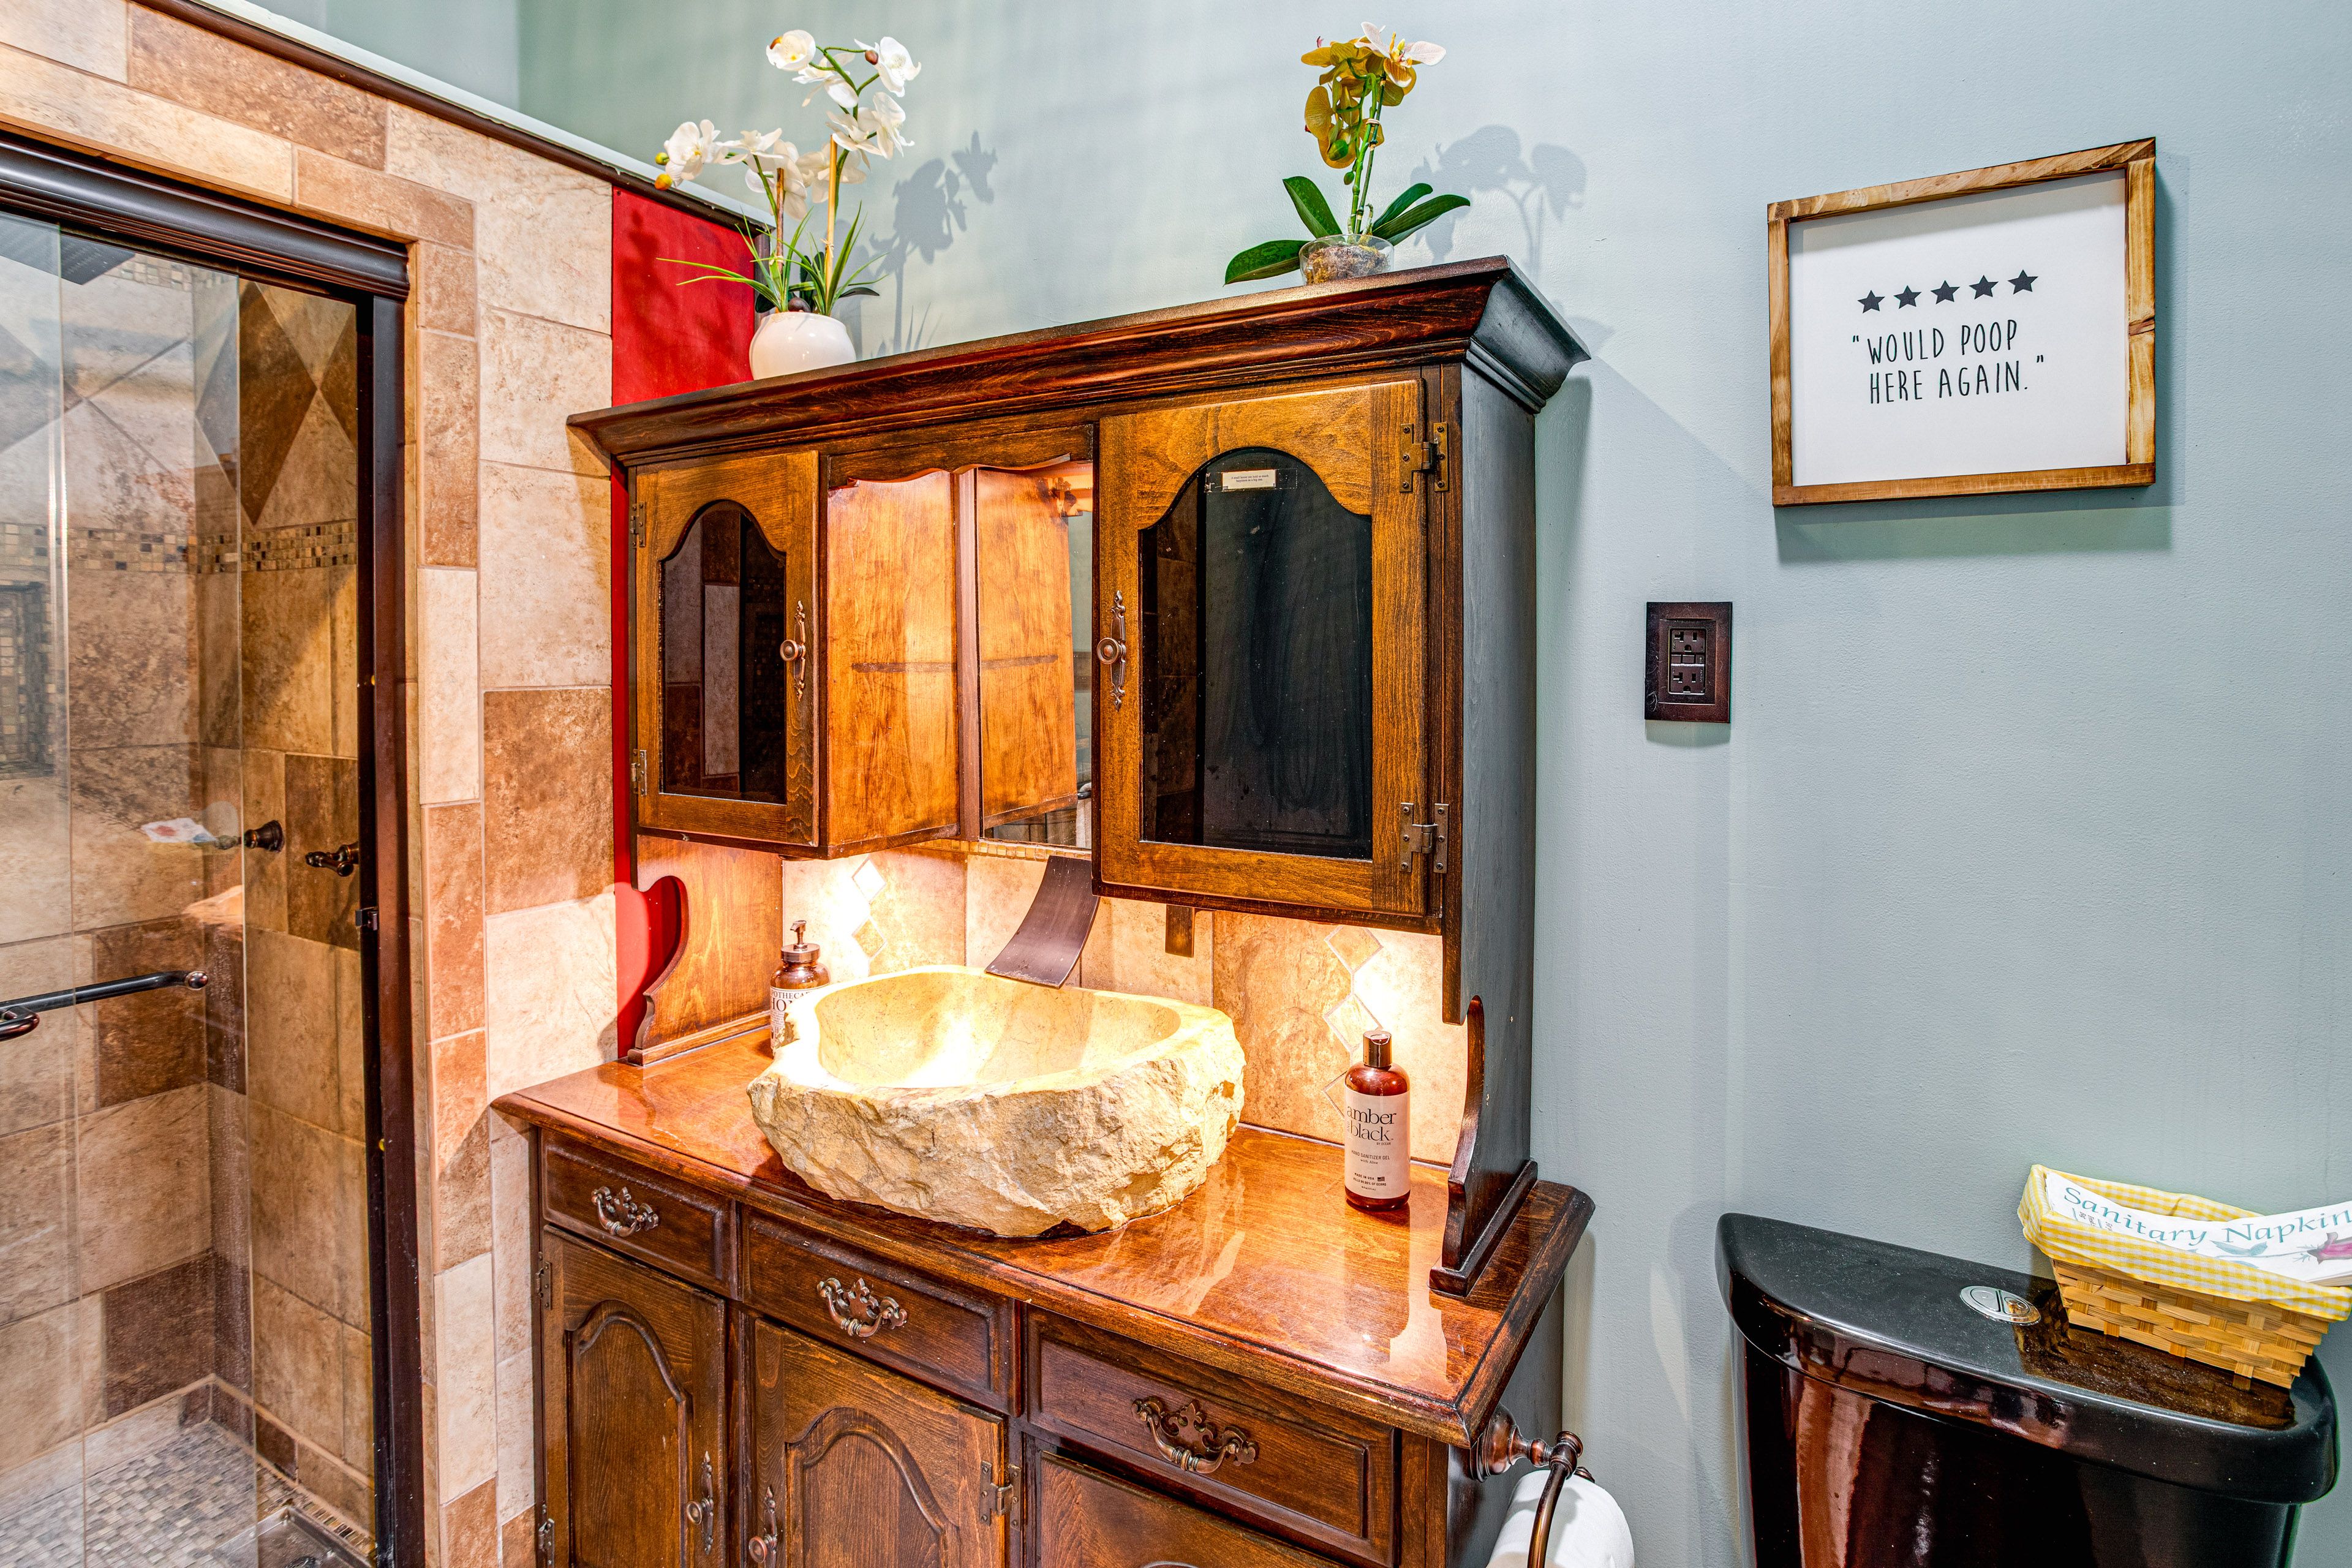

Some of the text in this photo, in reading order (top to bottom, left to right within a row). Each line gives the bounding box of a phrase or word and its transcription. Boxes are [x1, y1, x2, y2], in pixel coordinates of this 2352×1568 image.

[1961, 319, 2018, 356] POOP
[1869, 370, 1923, 404] HERE
[1347, 1106, 1396, 1125] amber
[1351, 1120, 1390, 1141] black
[2064, 1187, 2352, 1246] Sanitary Napkin
